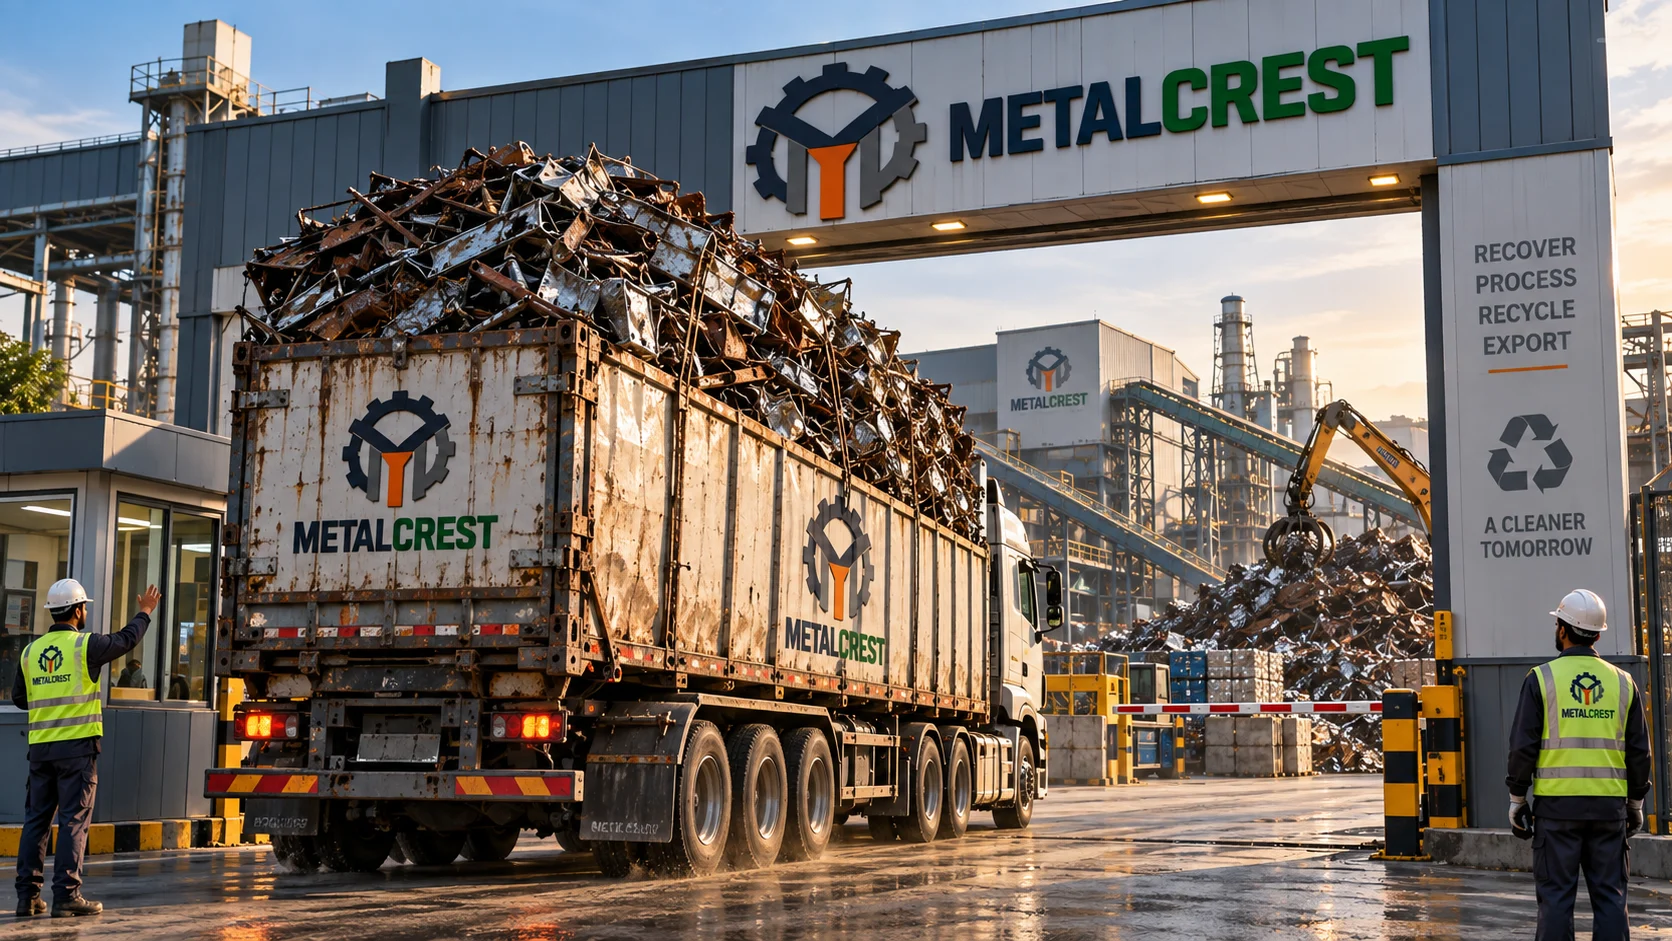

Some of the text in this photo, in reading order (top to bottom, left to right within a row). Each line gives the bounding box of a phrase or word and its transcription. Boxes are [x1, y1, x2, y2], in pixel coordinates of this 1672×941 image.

[949, 35, 1410, 162] METALCREST
[1474, 236, 1577, 264] RECOVER
[1476, 267, 1577, 294] PROCESS
[1478, 299, 1576, 325] RECYCLE
[1483, 330, 1572, 355] EXPORT
[1010, 392, 1089, 412] METALCREST
[292, 514, 499, 554] METALCREST
[1483, 512, 1586, 534] A CLEANER
[1480, 537, 1593, 558] TOMORROW
[784, 616, 886, 666] METALCREST
[1561, 708, 1616, 719] METALCREST
